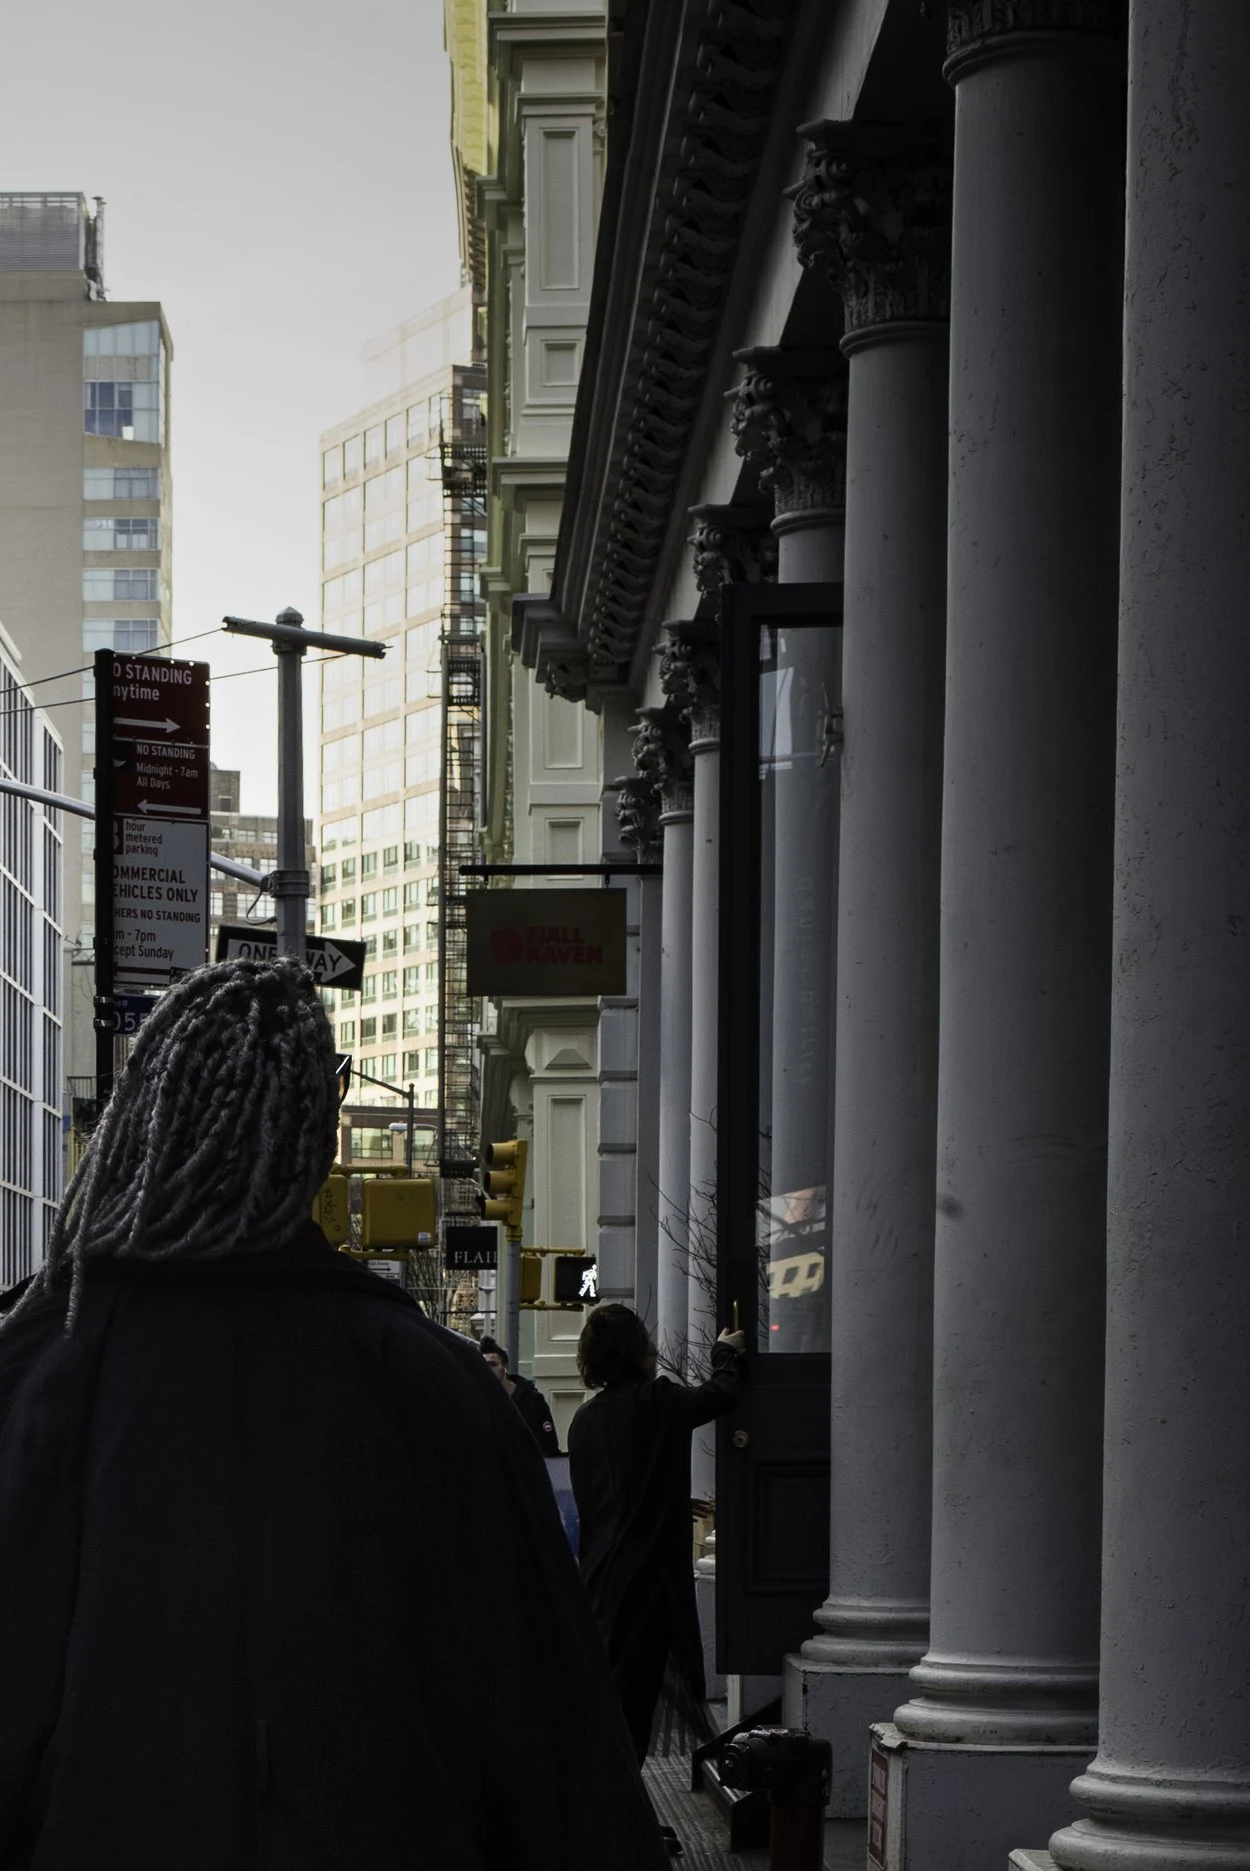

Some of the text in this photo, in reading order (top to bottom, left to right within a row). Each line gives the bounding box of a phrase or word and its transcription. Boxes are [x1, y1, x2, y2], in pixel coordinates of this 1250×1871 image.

[112, 662, 193, 686] O STANDING
[112, 683, 160, 701] nytime
[136, 743, 196, 760] NO STANDING
[136, 762, 173, 777] Midnight
[180, 766, 199, 779] 7am
[136, 776, 171, 791] All Days
[125, 820, 146, 832] hour
[125, 833, 163, 845] metered
[125, 844, 159, 858] parking
[112, 865, 186, 884] OMMERCIAL
[112, 883, 199, 903] EHICLES ONLY
[113, 907, 201, 923] HERS NO STANDING
[134, 928, 156, 942] 7pm
[113, 944, 175, 962] cept Sunday
